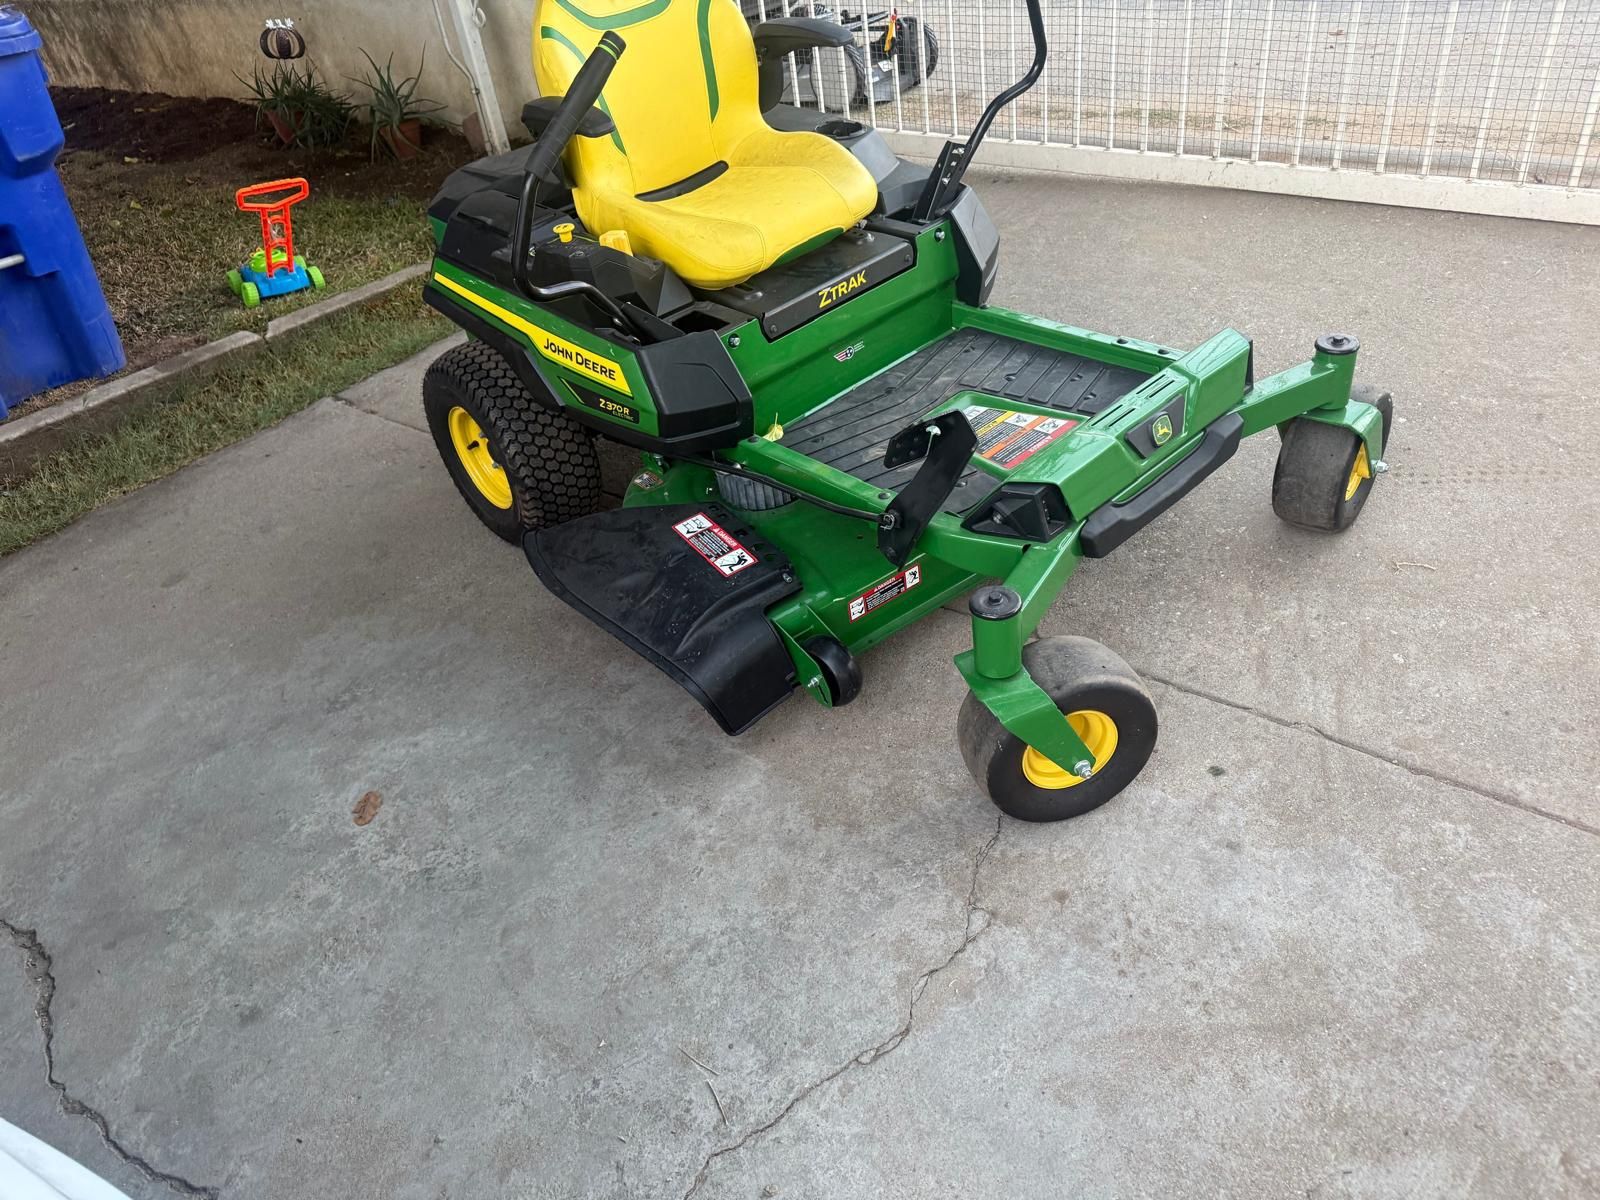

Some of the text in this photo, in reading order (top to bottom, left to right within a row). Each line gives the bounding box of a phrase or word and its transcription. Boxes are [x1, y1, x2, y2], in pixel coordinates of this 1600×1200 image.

[818, 269, 867, 308] ZTRAK
[544, 338, 616, 380] JOHN DEERE
